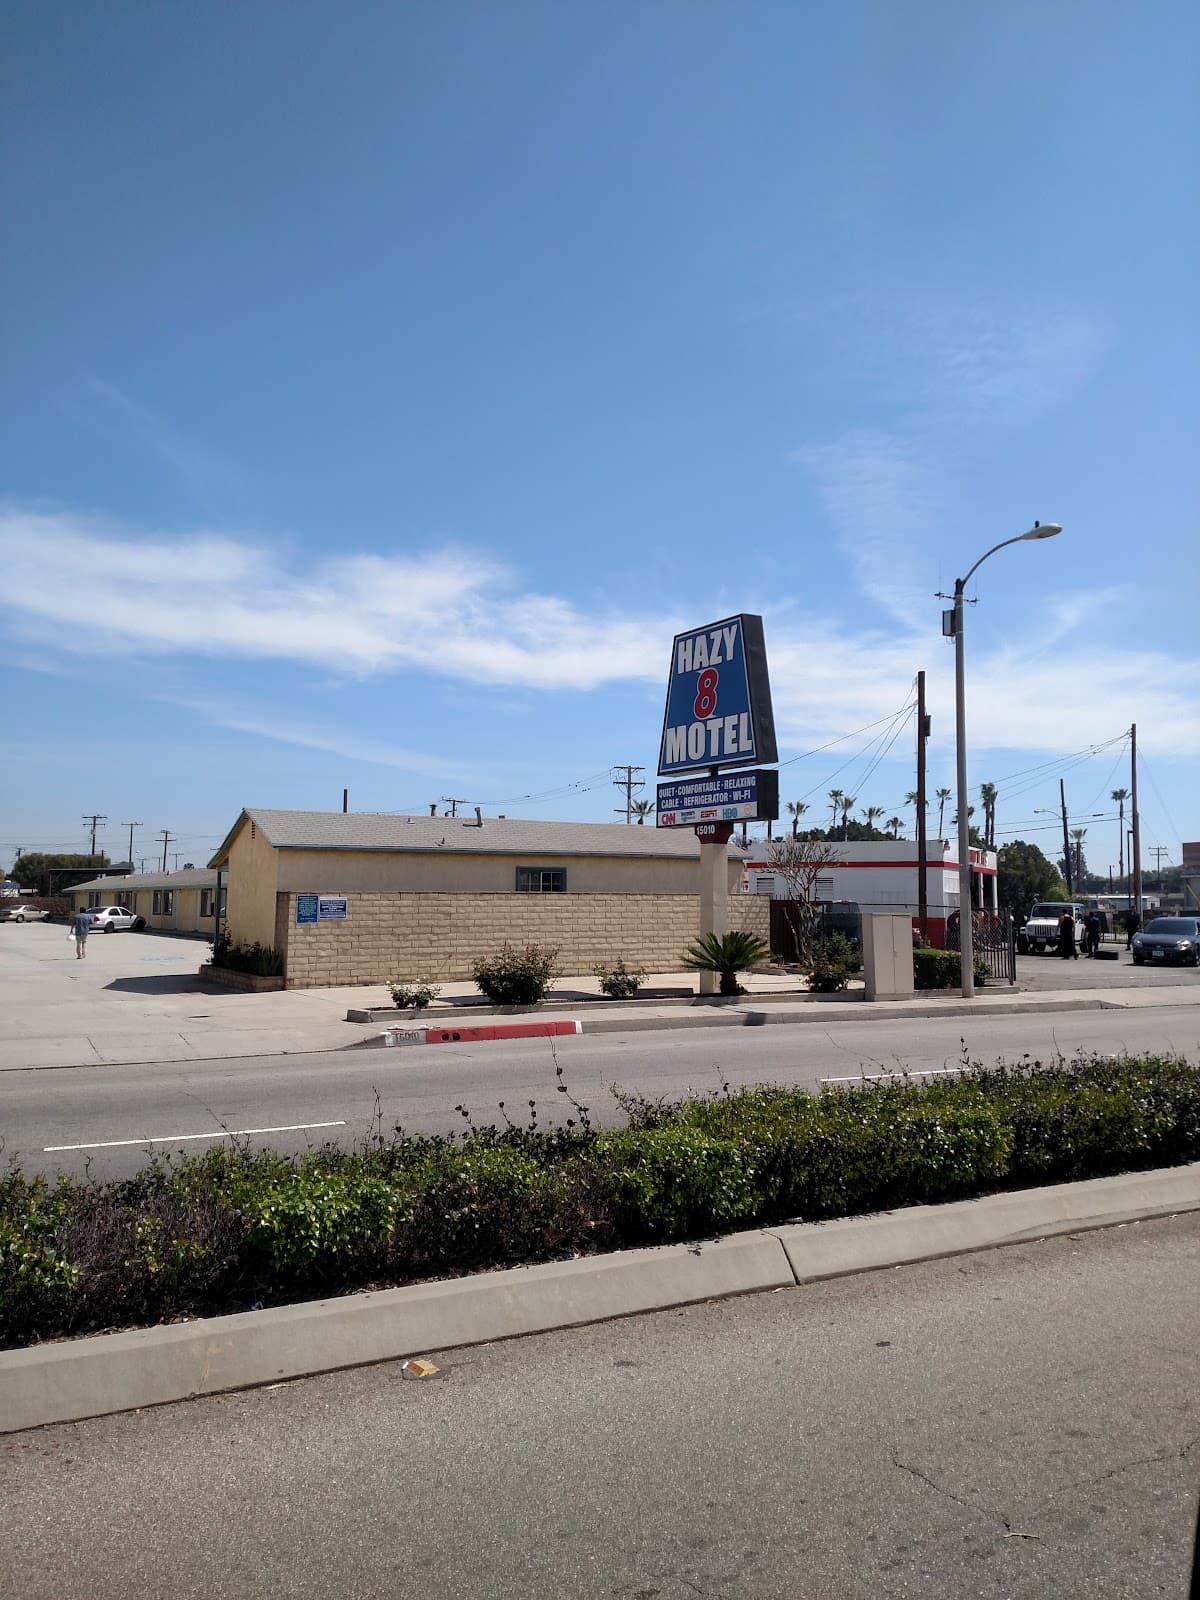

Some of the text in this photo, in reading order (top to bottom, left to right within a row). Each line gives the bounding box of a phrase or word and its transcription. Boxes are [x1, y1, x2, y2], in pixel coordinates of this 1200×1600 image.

[678, 624, 738, 674] HAZY
[693, 667, 719, 720] 8
[666, 712, 752, 764] MOTEL
[659, 776, 756, 798] QUIET COMFORTABLE RELAXING
[661, 790, 751, 809] CABLE REFRIGERATOR WI-FI
[662, 812, 675, 824] CNN
[700, 809, 717, 818] ESPN
[723, 807, 738, 820] HBO
[696, 825, 715, 835] 15010
